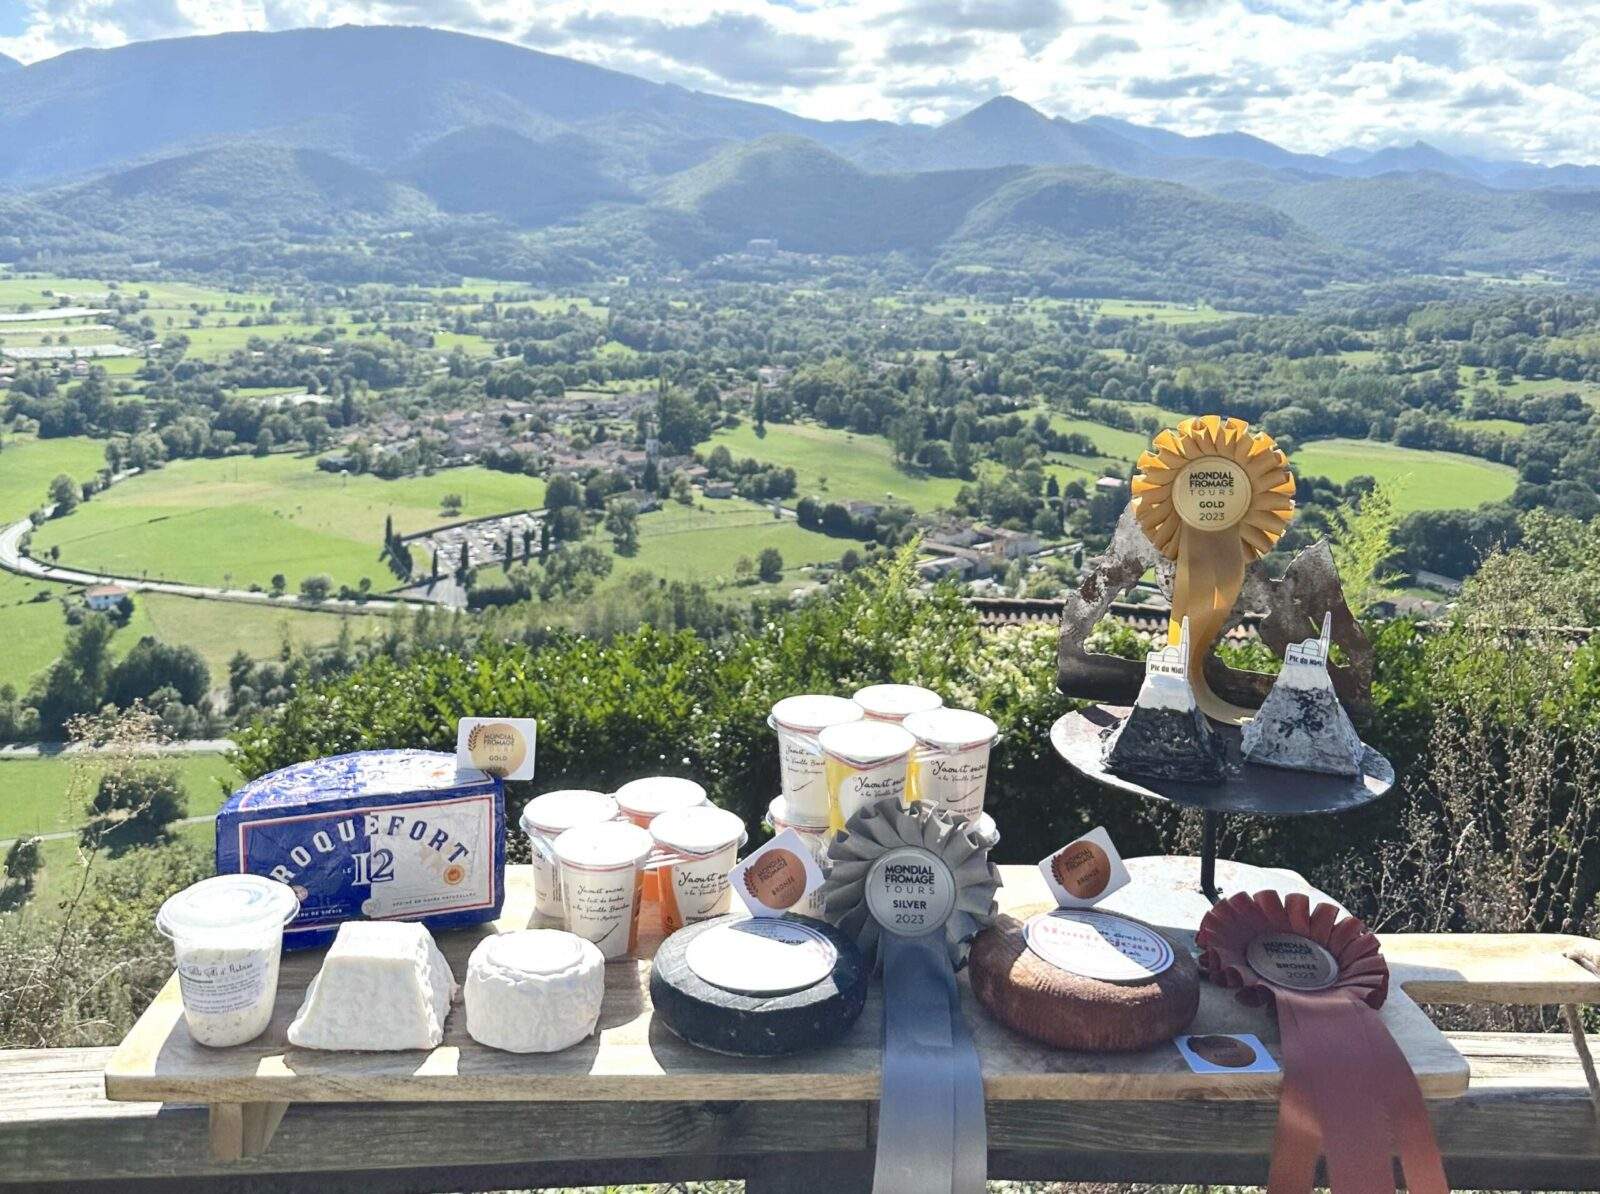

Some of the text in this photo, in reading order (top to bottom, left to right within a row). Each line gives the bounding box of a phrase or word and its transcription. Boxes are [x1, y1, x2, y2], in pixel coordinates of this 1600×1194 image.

[1190, 471, 1234, 480] MONDIAL
[1190, 480, 1234, 488] FROMAGE
[1200, 512, 1225, 521] 2023
[1289, 654, 1299, 663] Pic
[1150, 664, 1160, 672] Pic
[1171, 667, 1184, 675] Midi
[932, 760, 968, 776] Yaourt
[855, 776, 892, 791] Yaourt
[270, 813, 469, 884] ROQUEFORT
[351, 848, 395, 886] 12
[885, 865, 934, 875] MONDIAL
[678, 871, 719, 886] Yaourt
[885, 874, 935, 884] FROMAGE
[577, 884, 603, 895] Yaourt
[885, 885, 935, 894] TOURS
[893, 900, 927, 909] SILVER
[896, 914, 925, 924] 2023
[1276, 962, 1316, 970] BRONZE
